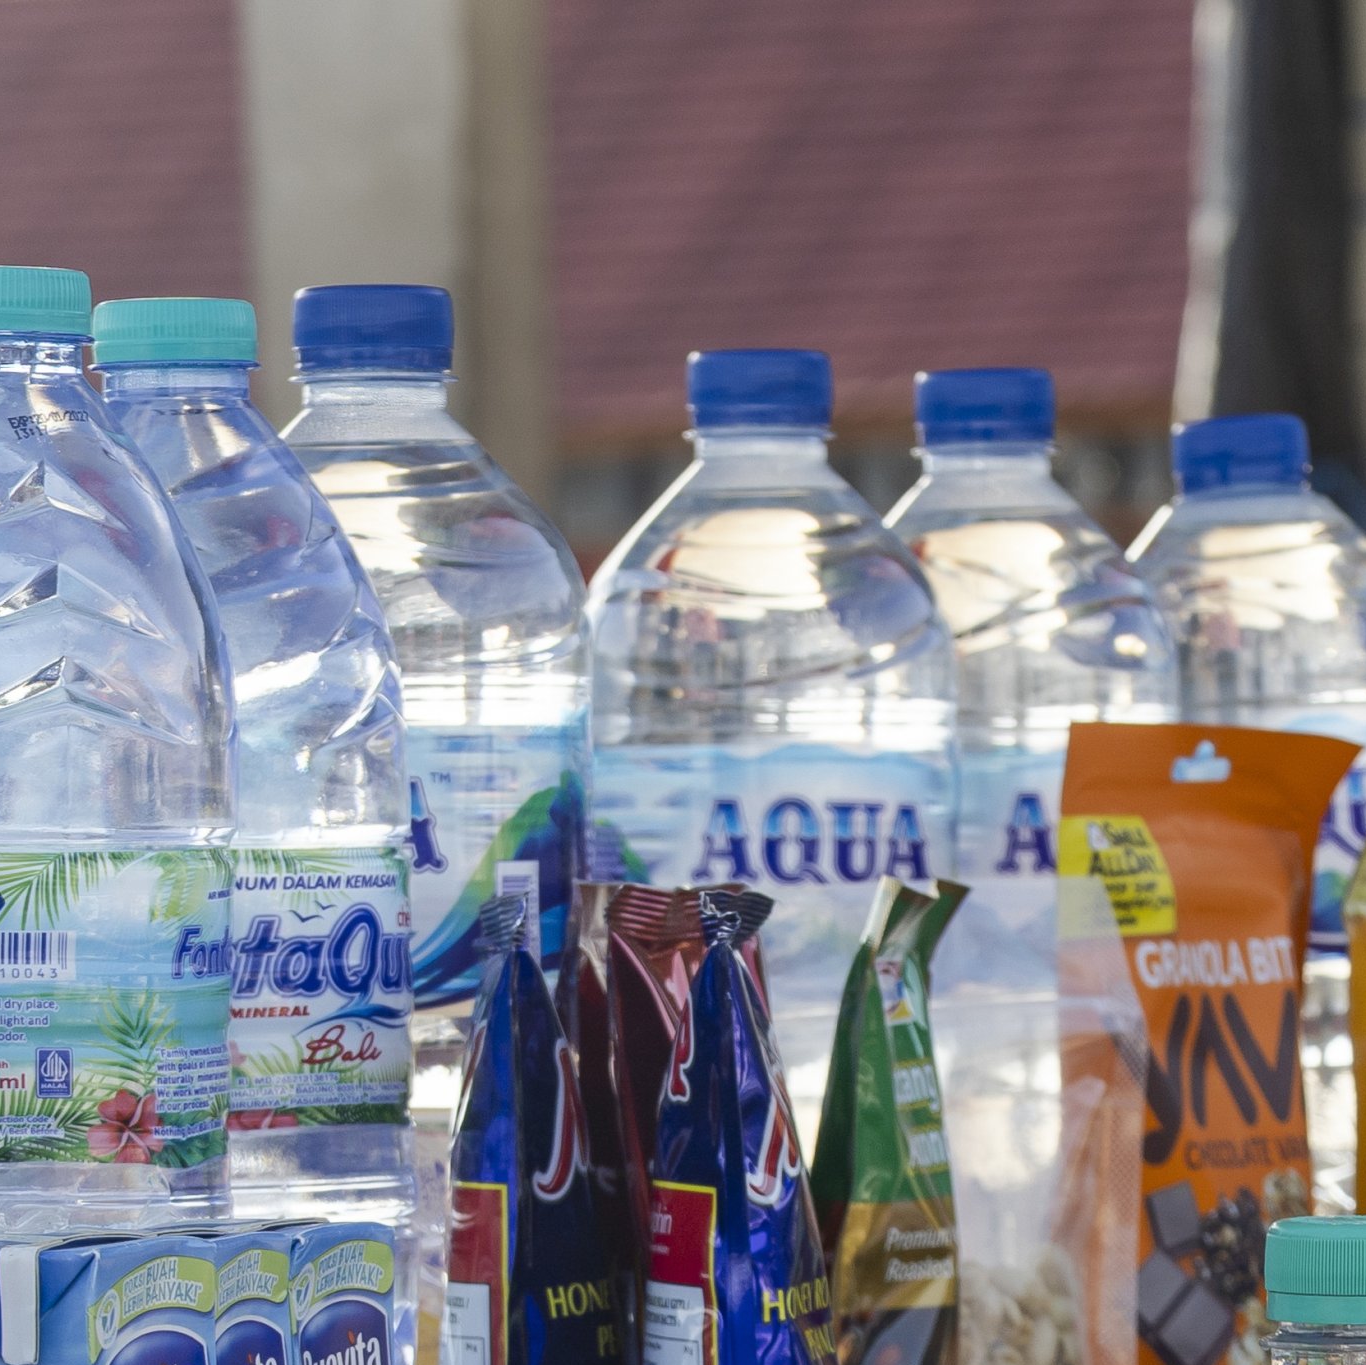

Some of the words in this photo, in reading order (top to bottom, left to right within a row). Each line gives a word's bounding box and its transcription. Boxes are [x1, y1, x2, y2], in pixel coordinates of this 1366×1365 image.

[691, 797, 931, 887] AQUA
[235, 876, 277, 890] NUM
[283, 874, 342, 890] DALAM
[345, 874, 398, 889] KEMASAN
[1136, 941, 1247, 988] GRANOLA
[1246, 935, 1296, 983] BIT
[4, 1000, 22, 1012] dry
[25, 999, 60, 1012] place,
[230, 1005, 310, 1019] MINERAL
[28, 1015, 49, 1026] and
[301, 1024, 382, 1066] Bali
[157, 1062, 176, 1071] with
[157, 1075, 194, 1085] naturally
[9, 1127, 28, 1135] Best
[154, 1126, 186, 1138] Nothing
[337, 1241, 366, 1266] BUAH
[146, 1258, 178, 1282] BUAH
[237, 1250, 263, 1275] BUAH
